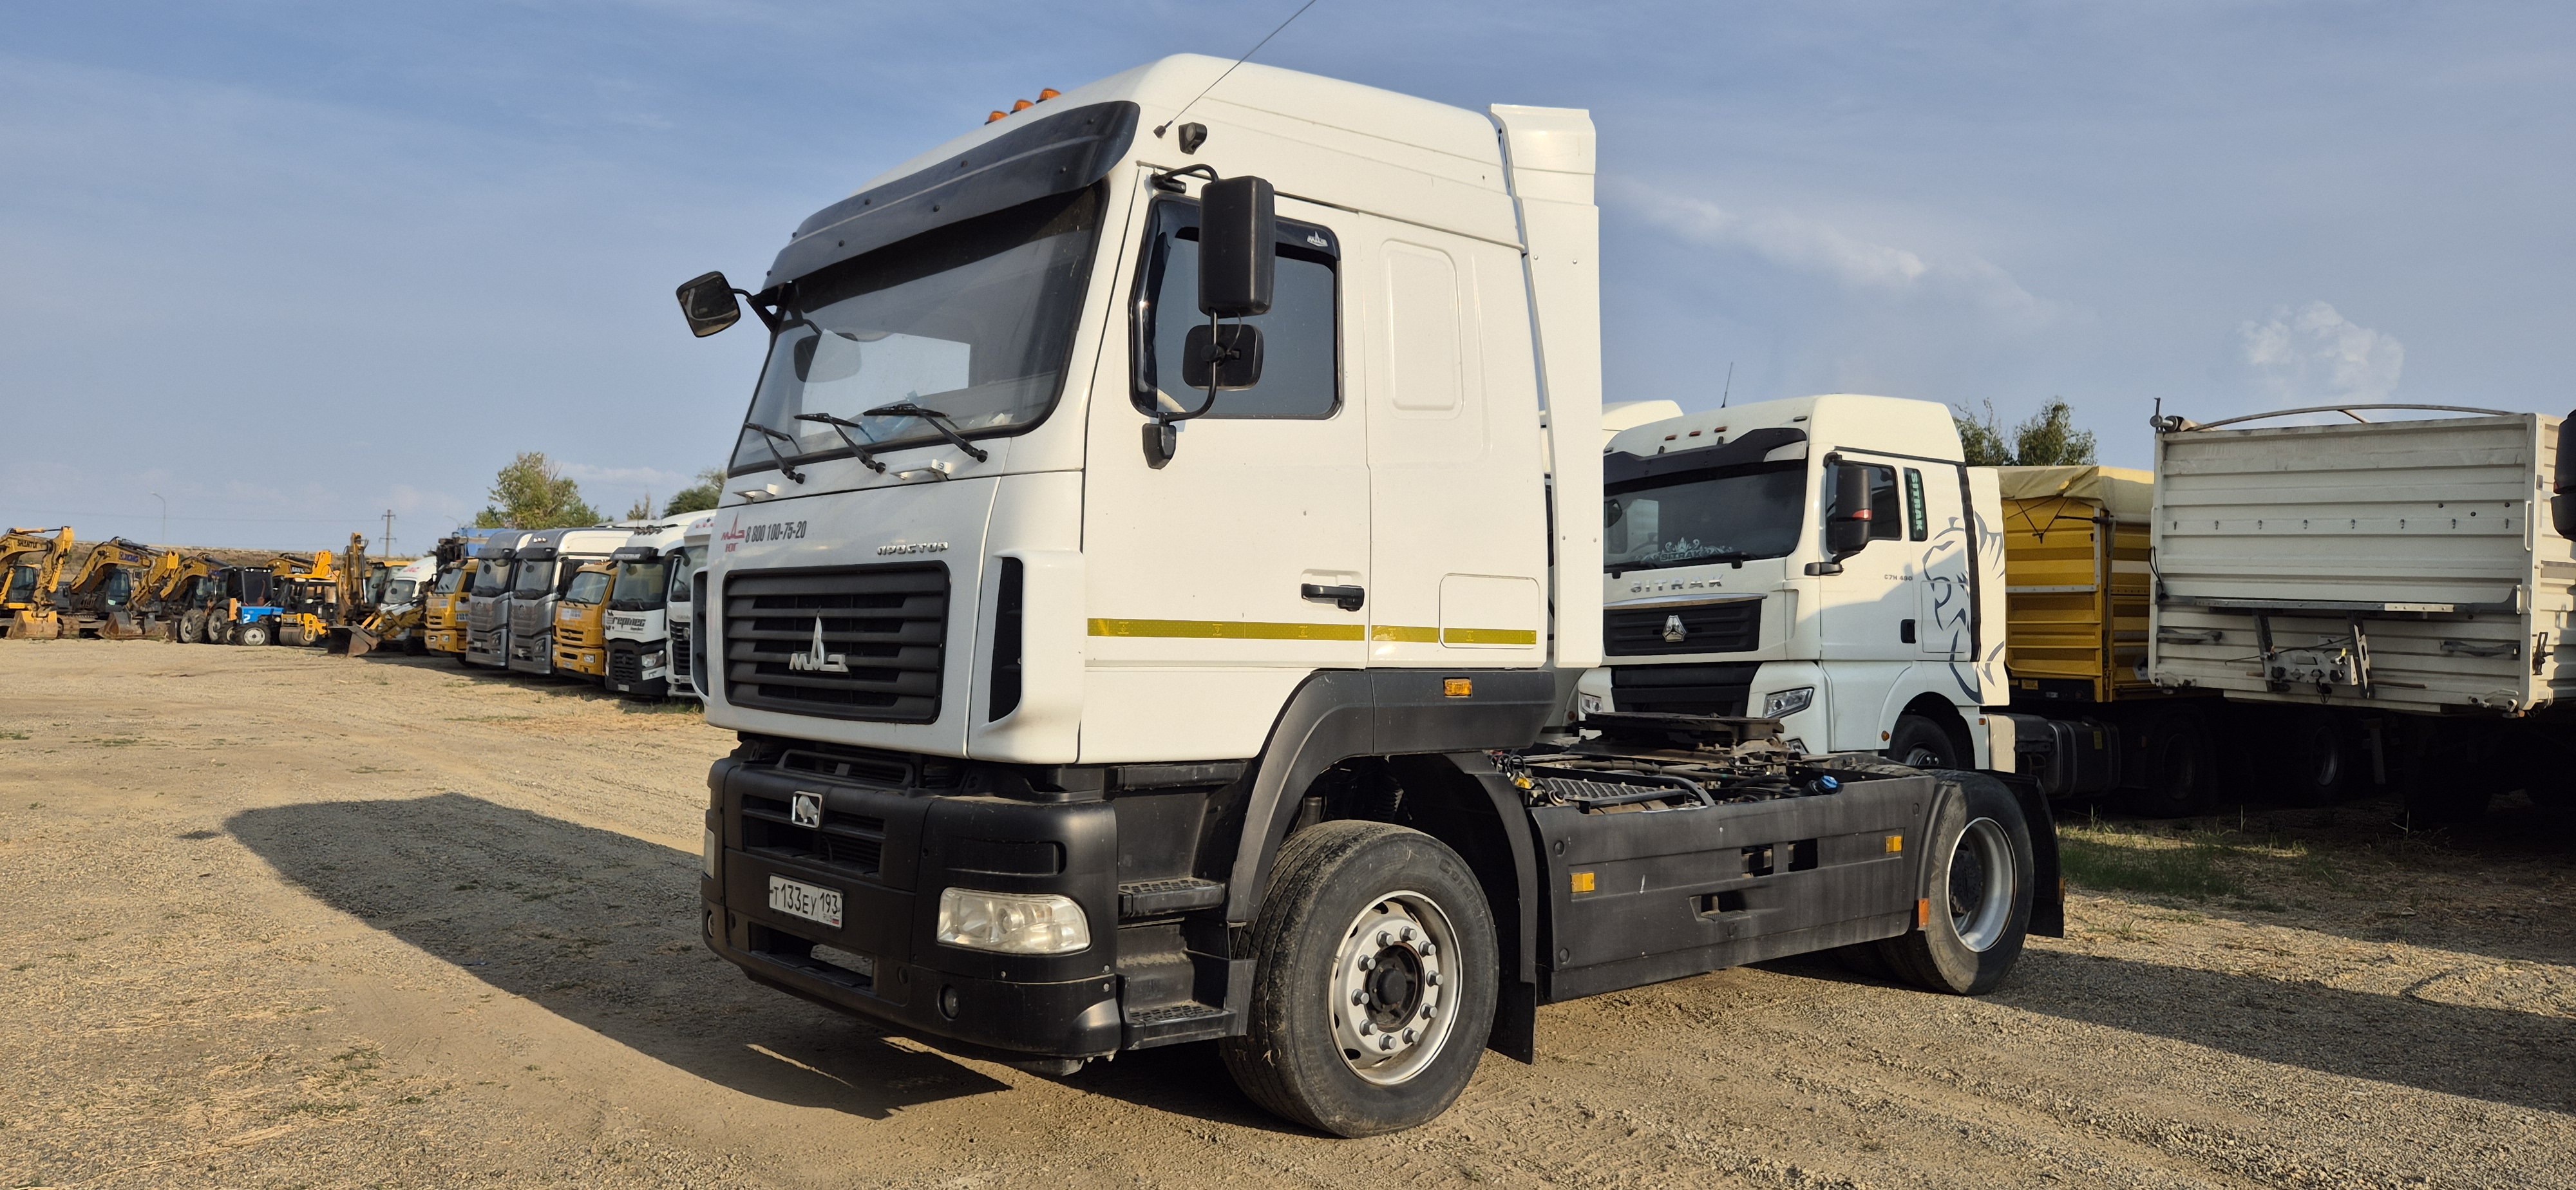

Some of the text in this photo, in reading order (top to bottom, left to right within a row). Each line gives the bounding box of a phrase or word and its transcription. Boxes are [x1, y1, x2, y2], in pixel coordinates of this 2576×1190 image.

[1911, 472, 1923, 531] SITRAK
[721, 511, 745, 541] МАЗ
[745, 520, 808, 543] 8 800 100-75-20
[724, 542, 739, 552] ЮГ
[877, 542, 949, 555] ПРОСТОР
[1661, 549, 1702, 561] SITRAK
[1630, 574, 1723, 593] SITRAK
[819, 892, 838, 914] 193
